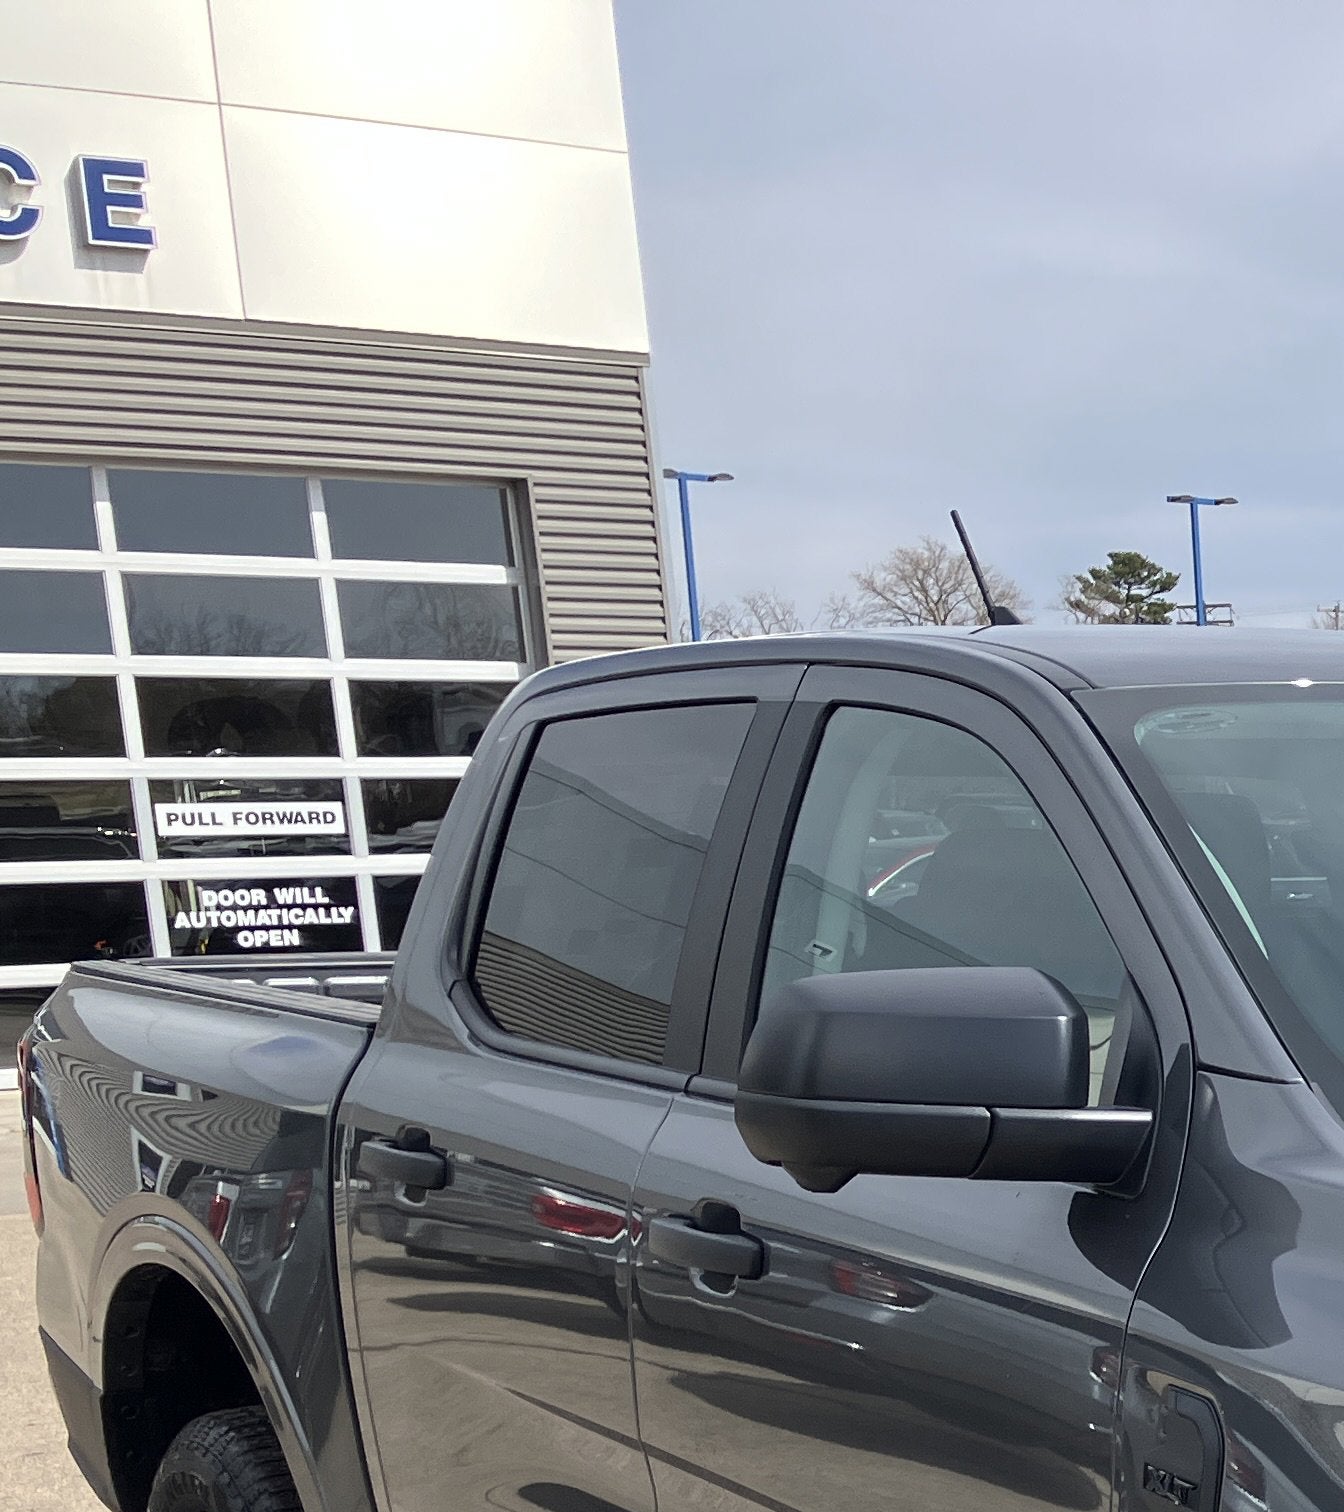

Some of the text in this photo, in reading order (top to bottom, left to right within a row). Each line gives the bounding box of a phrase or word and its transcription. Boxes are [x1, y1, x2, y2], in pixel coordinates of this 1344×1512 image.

[166, 811, 336, 826] PULL FORWARD
[202, 886, 330, 907] DOOR WILL
[174, 906, 354, 929] AUTOMATICALLY
[237, 928, 300, 948] OPEN
